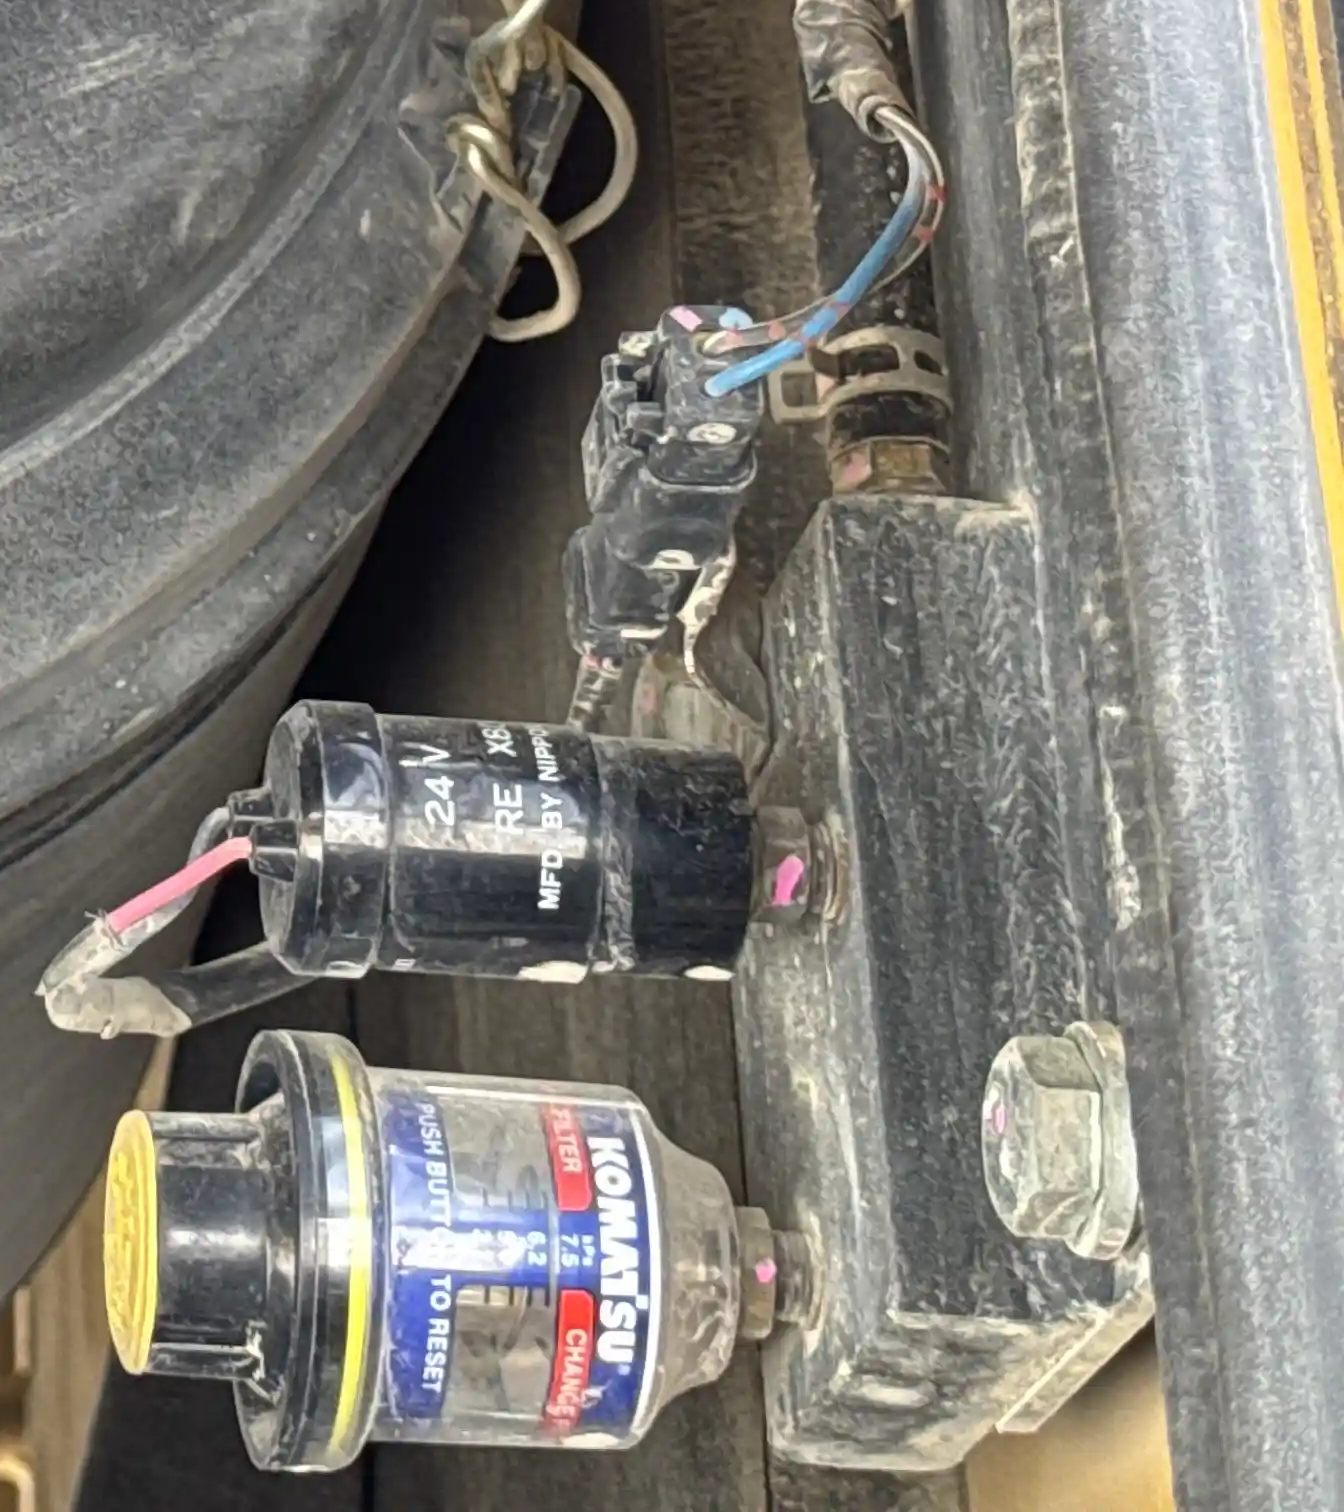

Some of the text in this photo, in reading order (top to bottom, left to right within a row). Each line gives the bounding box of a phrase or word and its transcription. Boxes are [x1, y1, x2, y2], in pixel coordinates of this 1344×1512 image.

[420, 743, 455, 826] 24 V
[493, 783, 524, 835] RE
[540, 792, 564, 829] BY
[416, 1103, 444, 1155] PUSH
[551, 1108, 582, 1173] FILTER
[527, 1231, 548, 1266] 6.2
[560, 1233, 580, 1266] 7.5
[587, 1136, 649, 1364] KOMATSU
[429, 1274, 452, 1311] TO
[422, 1319, 450, 1392] RESET
[557, 1328, 587, 1418] CHANGE
